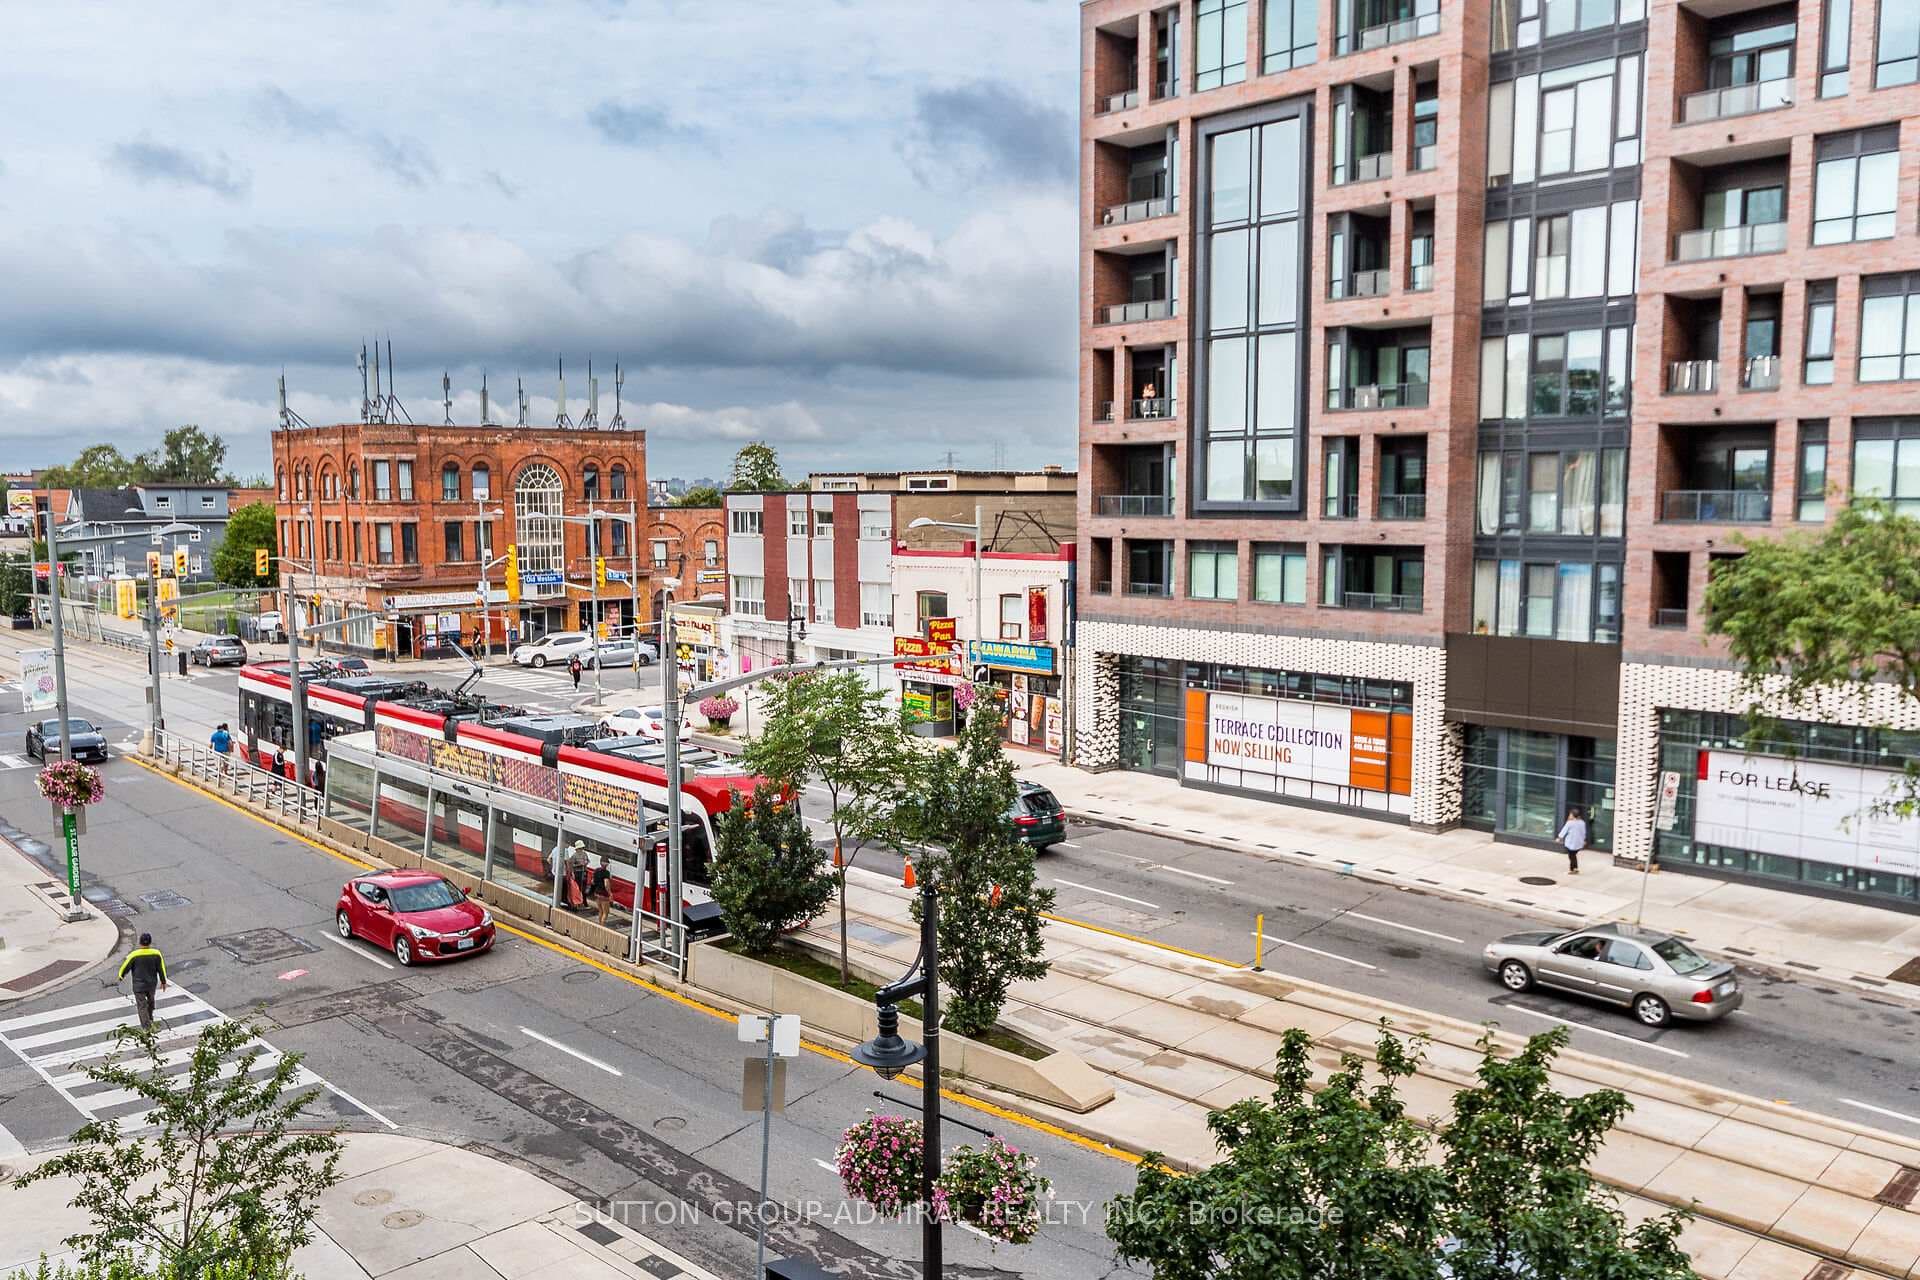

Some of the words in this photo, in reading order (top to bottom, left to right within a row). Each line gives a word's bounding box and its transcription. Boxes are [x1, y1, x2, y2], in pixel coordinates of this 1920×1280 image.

[929, 620, 954, 630] Pizza
[895, 637, 923, 653] Pizza
[932, 631, 951, 641] Pan
[1214, 718, 1264, 740] TERRACE
[1267, 724, 1343, 750] COLLECTION
[1214, 738, 1241, 756] NOW
[1244, 741, 1292, 763] SELLING
[1719, 770, 1758, 787] FOR
[1765, 775, 1831, 799] LEASE
